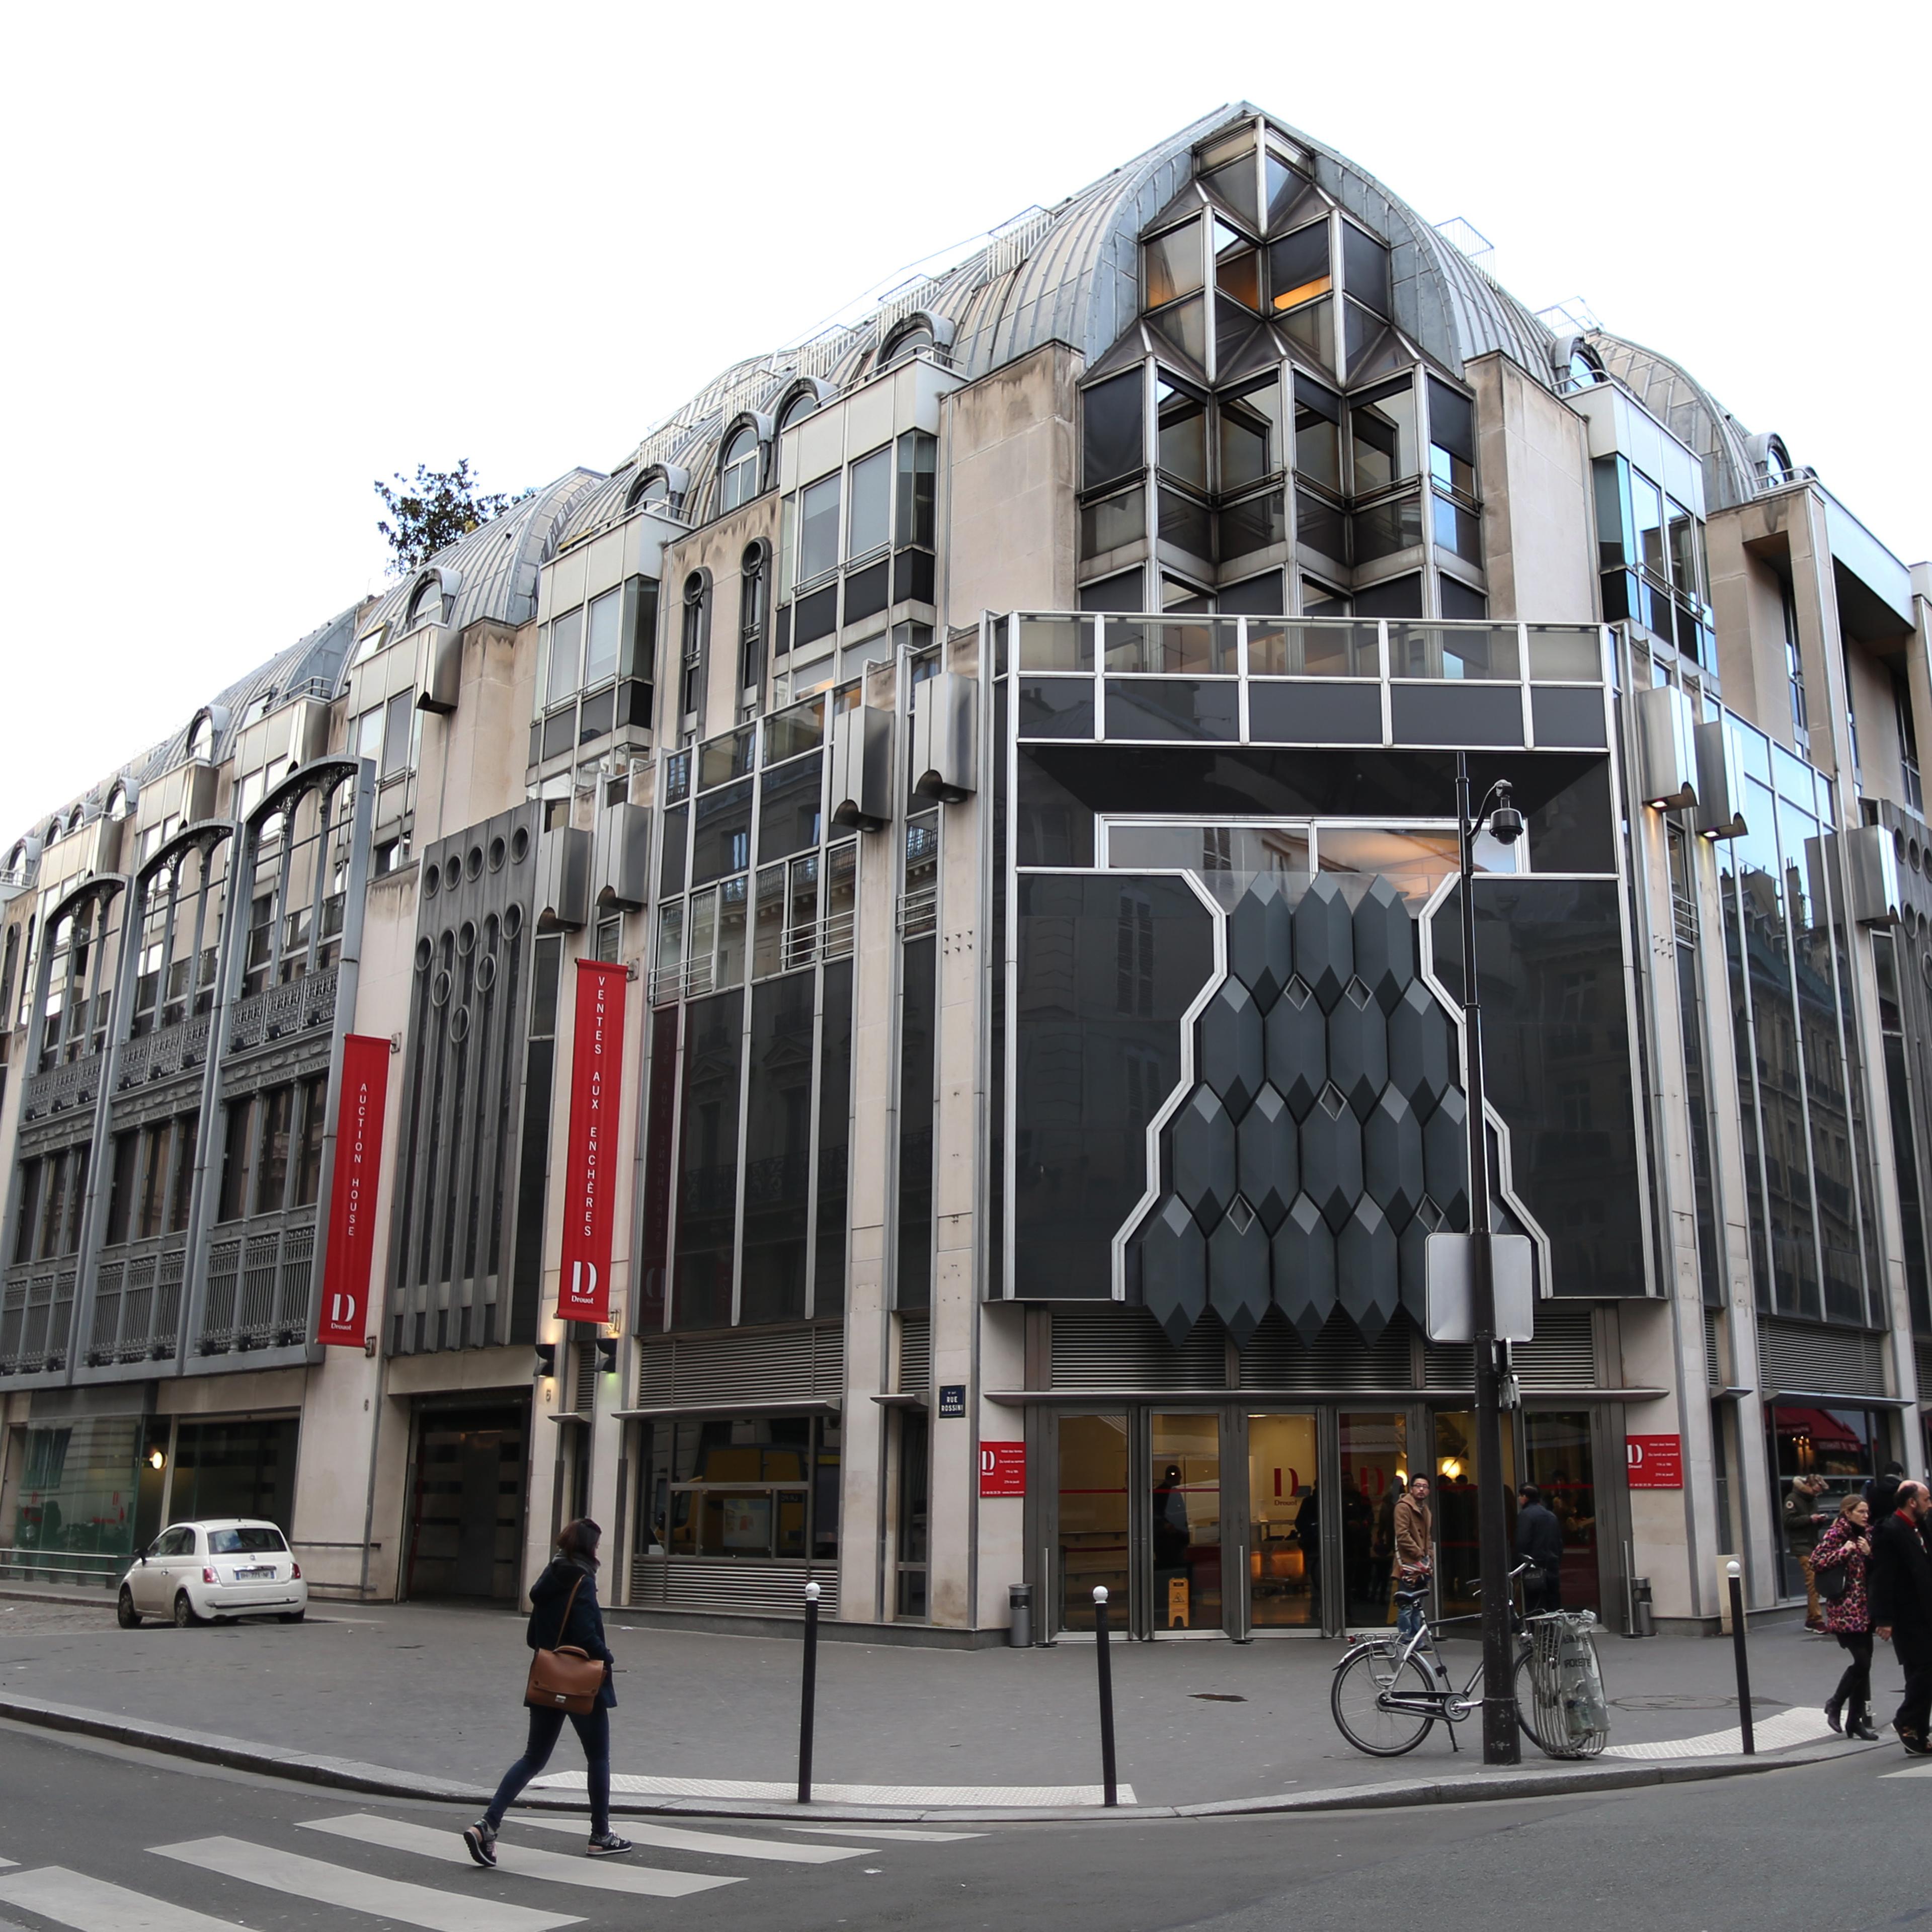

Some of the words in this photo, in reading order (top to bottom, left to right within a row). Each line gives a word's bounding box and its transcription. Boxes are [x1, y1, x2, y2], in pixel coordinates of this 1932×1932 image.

[595, 976, 605, 1055] VENTES
[354, 1083, 367, 1163] AUCTION
[592, 1071, 600, 1109] AUX
[348, 1178, 359, 1236] HOUSE
[584, 1126, 597, 1236] ENCHÈRES
[572, 1295, 594, 1304] Drouot
